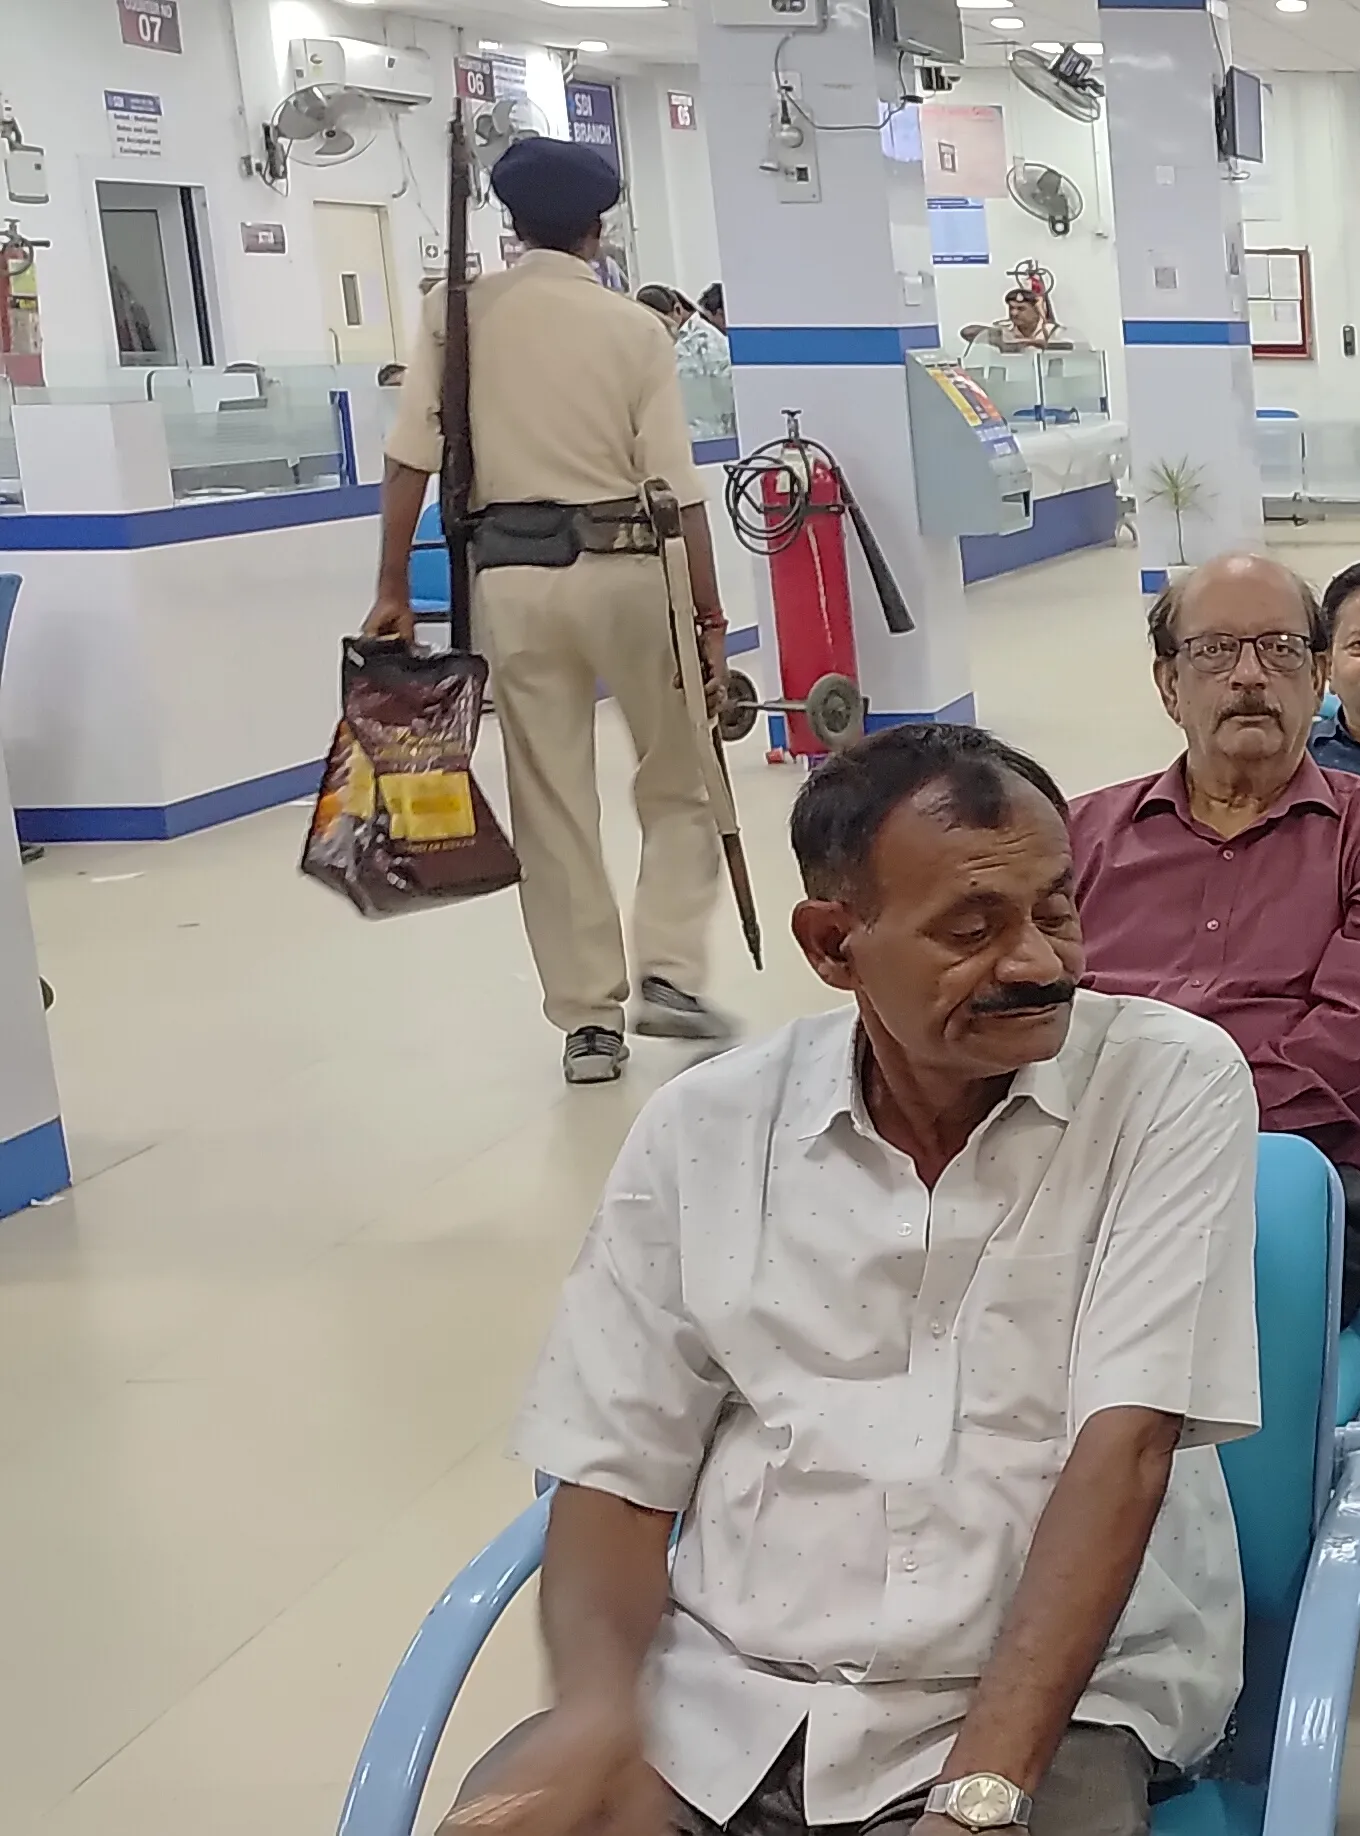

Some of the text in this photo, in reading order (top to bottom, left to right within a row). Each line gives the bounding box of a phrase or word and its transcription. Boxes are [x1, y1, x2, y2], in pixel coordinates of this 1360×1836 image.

[138, 13, 162, 43] 07
[467, 71, 485, 96] 06
[574, 92, 593, 117] SBI
[573, 121, 611, 145] BRANCH
